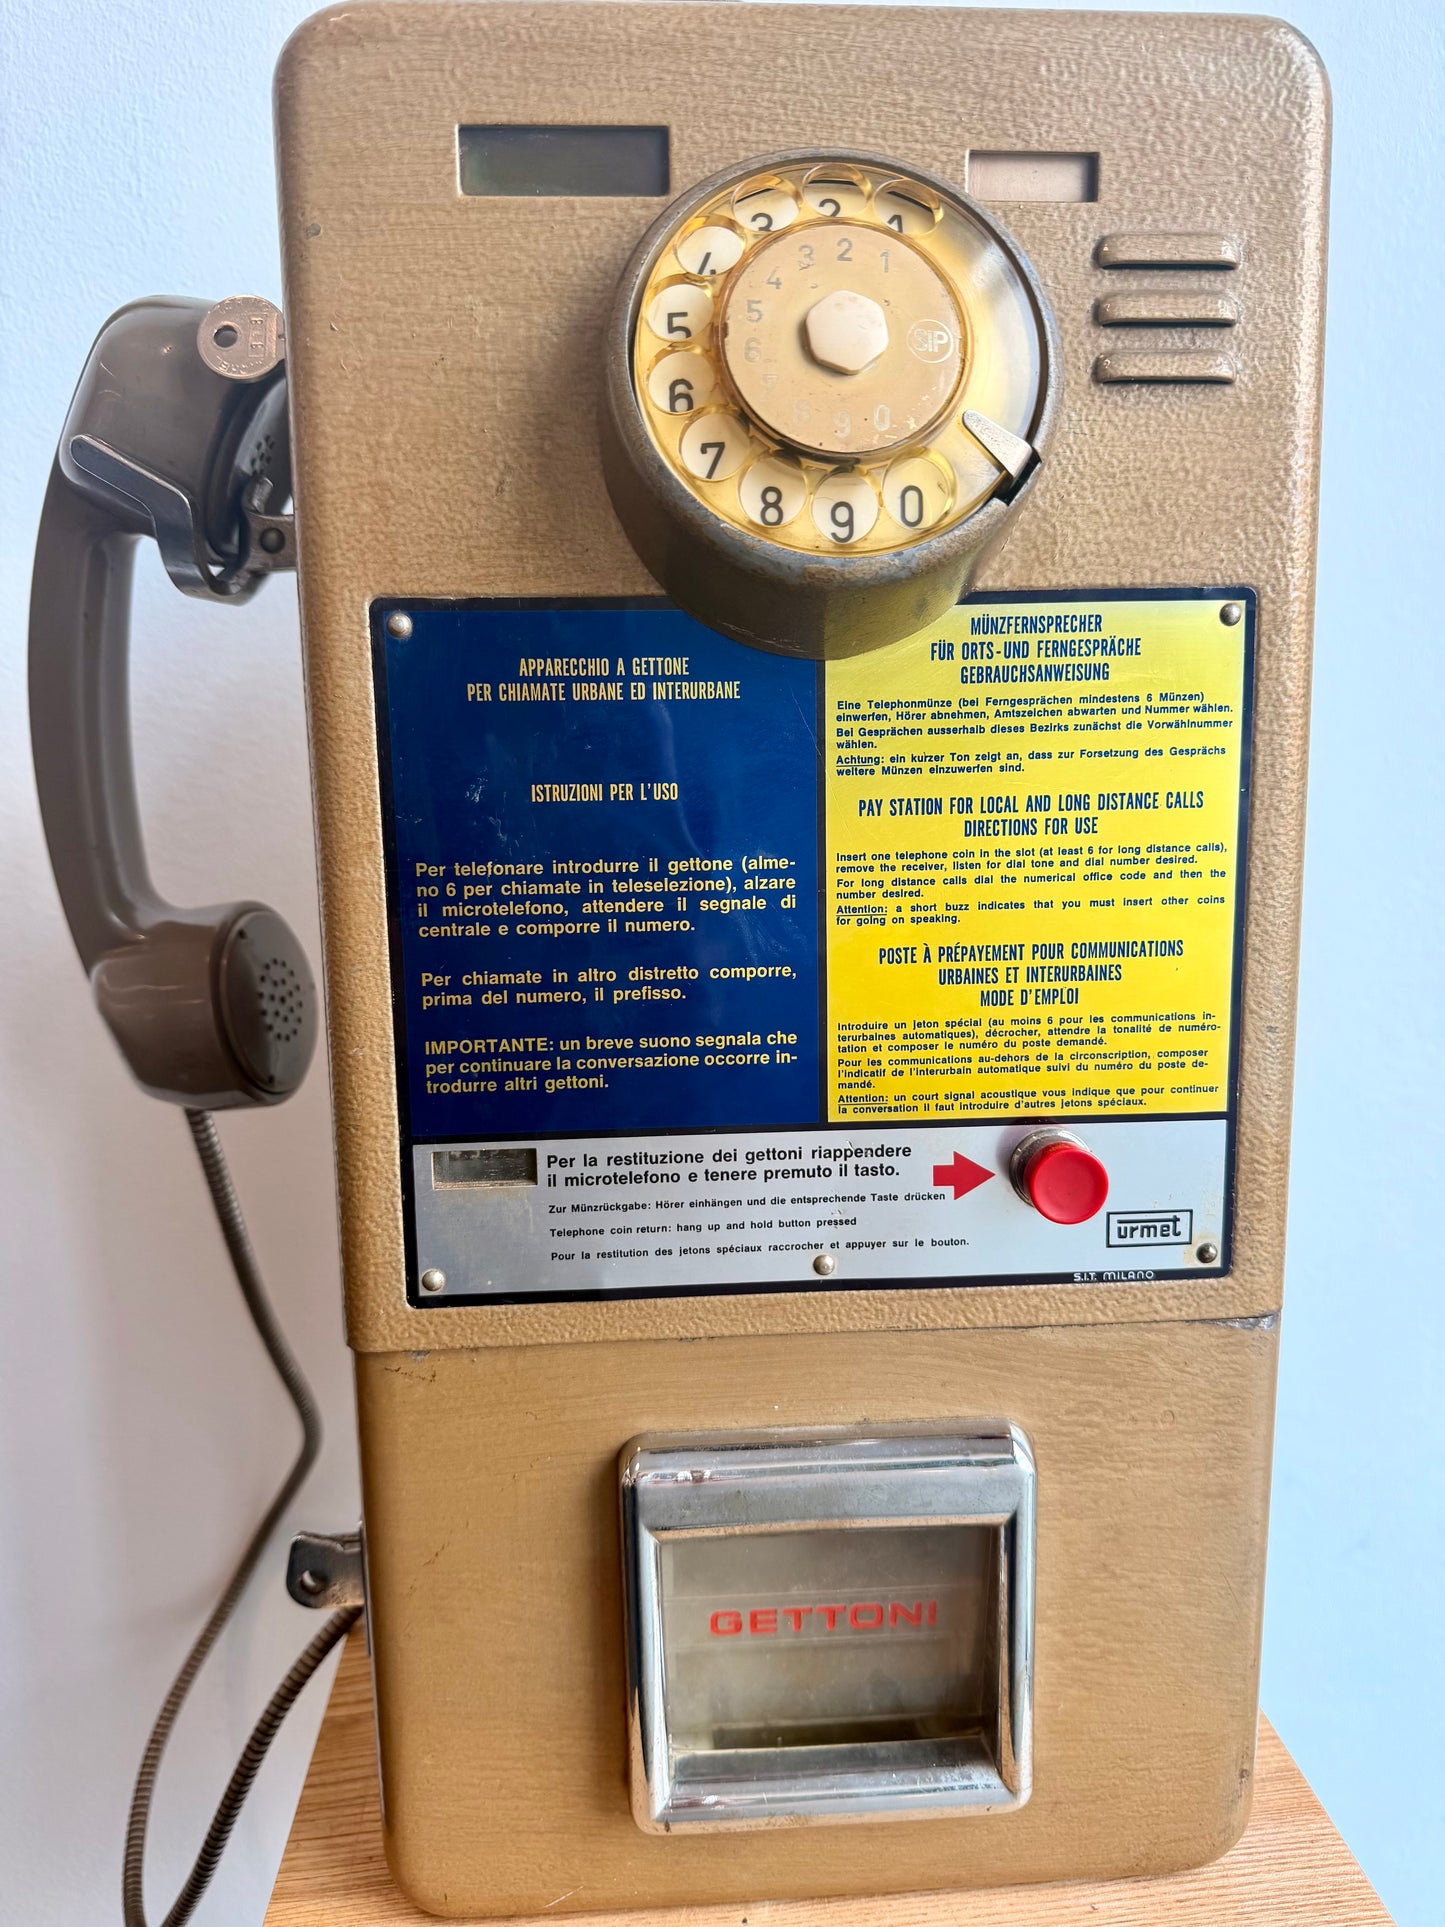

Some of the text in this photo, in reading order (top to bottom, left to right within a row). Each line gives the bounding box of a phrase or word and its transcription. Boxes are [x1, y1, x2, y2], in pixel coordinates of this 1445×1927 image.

[799, 244, 814, 269] 3
[837, 238, 853, 261] 2
[880, 249, 889, 273] 1
[766, 266, 782, 289] 4
[746, 300, 762, 323] 5
[667, 312, 692, 339] 5
[744, 336, 761, 363] 6
[668, 378, 694, 413] 6
[833, 411, 851, 438] 9
[873, 404, 891, 432] 0
[700, 442, 726, 479] 7
[760, 486, 784, 526] 8
[900, 485, 924, 528] 0
[830, 501, 854, 543] 9
[970, 613, 1102, 635] MÜNZFERNSPRECHER
[930, 639, 954, 660] FÜR
[1037, 635, 1141, 658] FERNGESPRÄCHE
[519, 657, 689, 676] APPARECCHIO A GETTONE
[960, 662, 1109, 684] GEBRAUCHSANWEISUNG
[467, 681, 740, 701] PER CHIAMATE URBANE ED INTERURBANE
[837, 691, 1204, 711] Eine Telephonmünze (bei Ferngesprächen mindestens 6 Münzen)
[835, 762, 1024, 776] weitere Münzen einzuwerfen sind.
[531, 782, 678, 802] ISTRUZIONI PER L'USO
[858, 790, 1203, 816] PAY STATION FOR LOCAL AND LONG DISTANCE CALLS
[964, 816, 1098, 837] DIRECTIONS FOR USE
[416, 855, 795, 877] Per telefonare introdurre il gettone (alme-
[417, 875, 795, 899] no 6 per chiamate in teleselezione), alzare
[836, 888, 923, 899] number desired.
[418, 894, 795, 916] il microtelefono, attendere il segnale di
[419, 918, 695, 937] centrale e comporre il numero.
[879, 939, 1183, 964] POSTE À PRÉPAYEMENT POUR COMMUNICATIONS
[938, 964, 1121, 985] URBAINES ET INTERURBAINES
[980, 987, 1078, 1006] MODE D'EMPLOI
[425, 1030, 797, 1054] IMPORTANTE: un breve suono segnala che
[837, 1036, 1106, 1053] tation et composer le numéro du poste demandé.
[426, 1049, 797, 1077] per continuare la conversazione occorre in-
[426, 1074, 608, 1093] trodurre altri gettoni.
[546, 1144, 911, 1168] Per la restituzione dei gettoni riappendere
[547, 1163, 899, 1187] il microtelefono e tenere premuto il tasto.
[548, 1192, 945, 1213] Zur Münzrückgabe: Hörer einhängen und die entsprechende Taste drücken
[549, 1216, 856, 1238] Telephone coin return: hang up and hold button pressed
[1116, 1214, 1181, 1239] urmet
[710, 1600, 937, 1636] GETTONI
